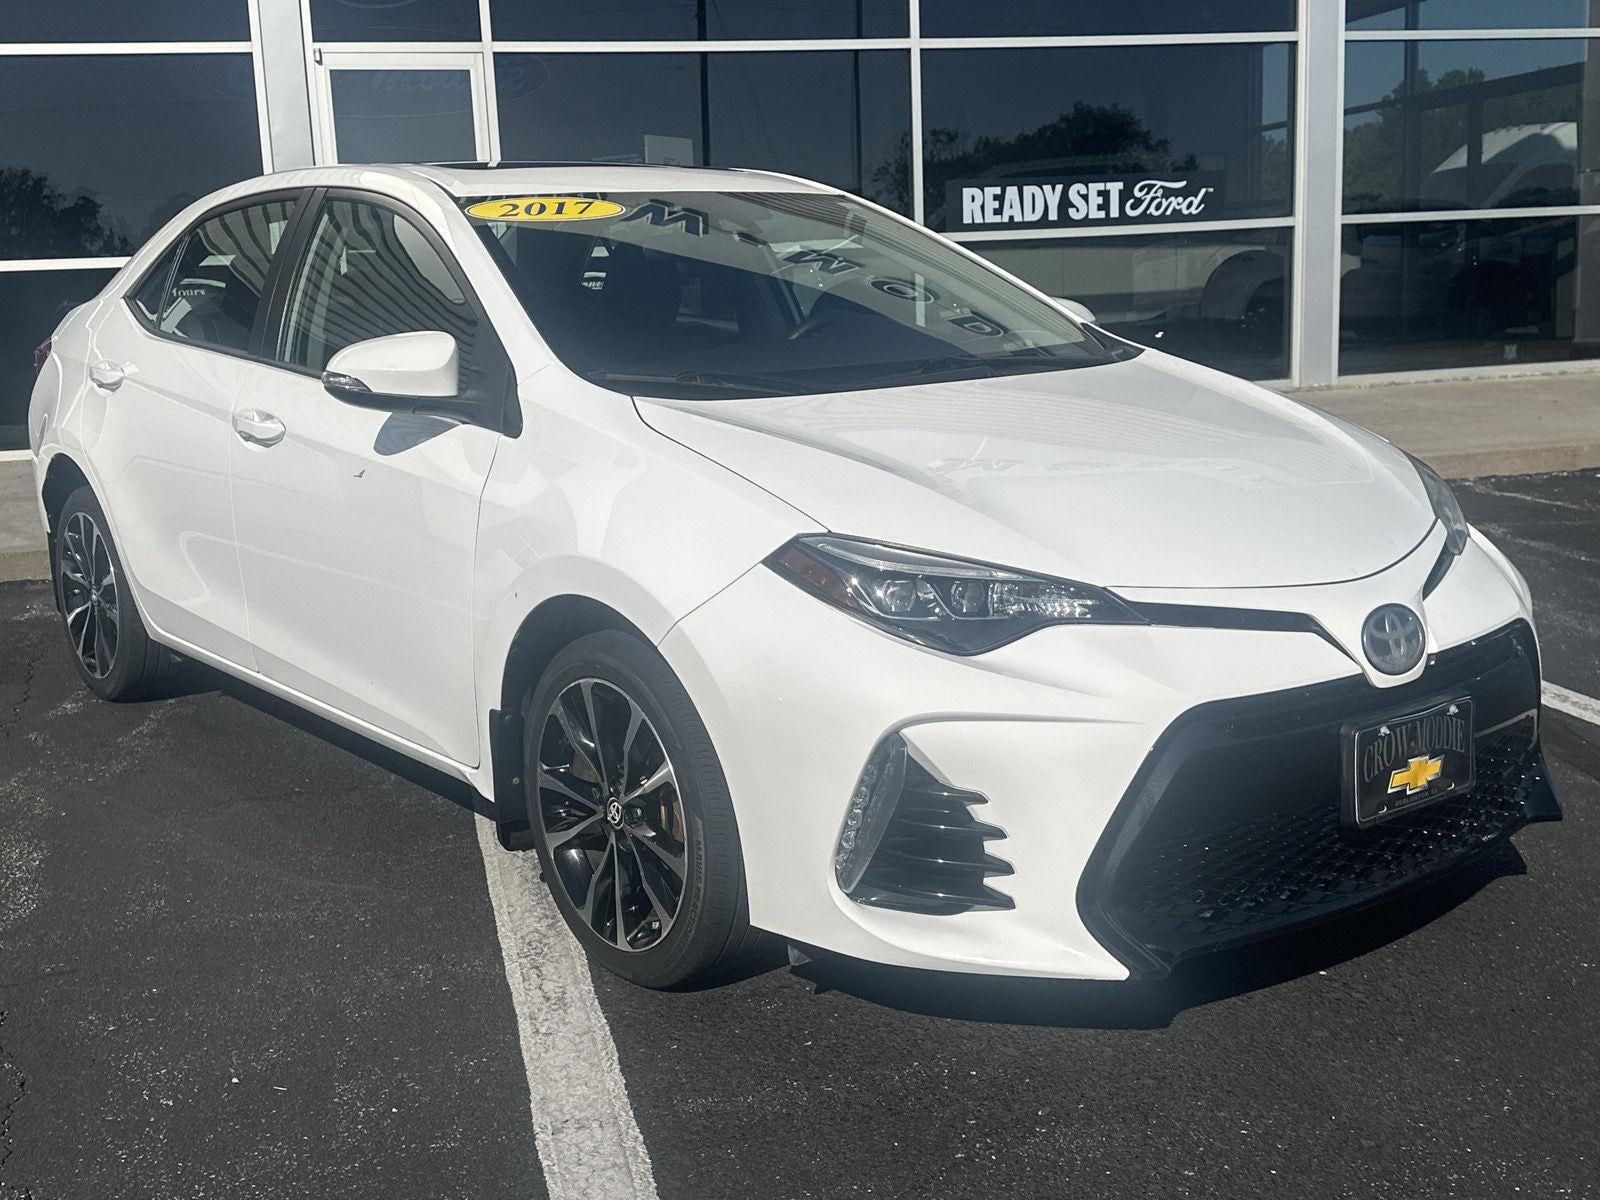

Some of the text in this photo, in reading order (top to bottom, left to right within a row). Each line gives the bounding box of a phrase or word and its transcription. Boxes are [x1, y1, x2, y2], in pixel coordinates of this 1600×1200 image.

[498, 200, 595, 218] 2017
[962, 183, 1064, 224] READY
[1068, 181, 1124, 220] SET
